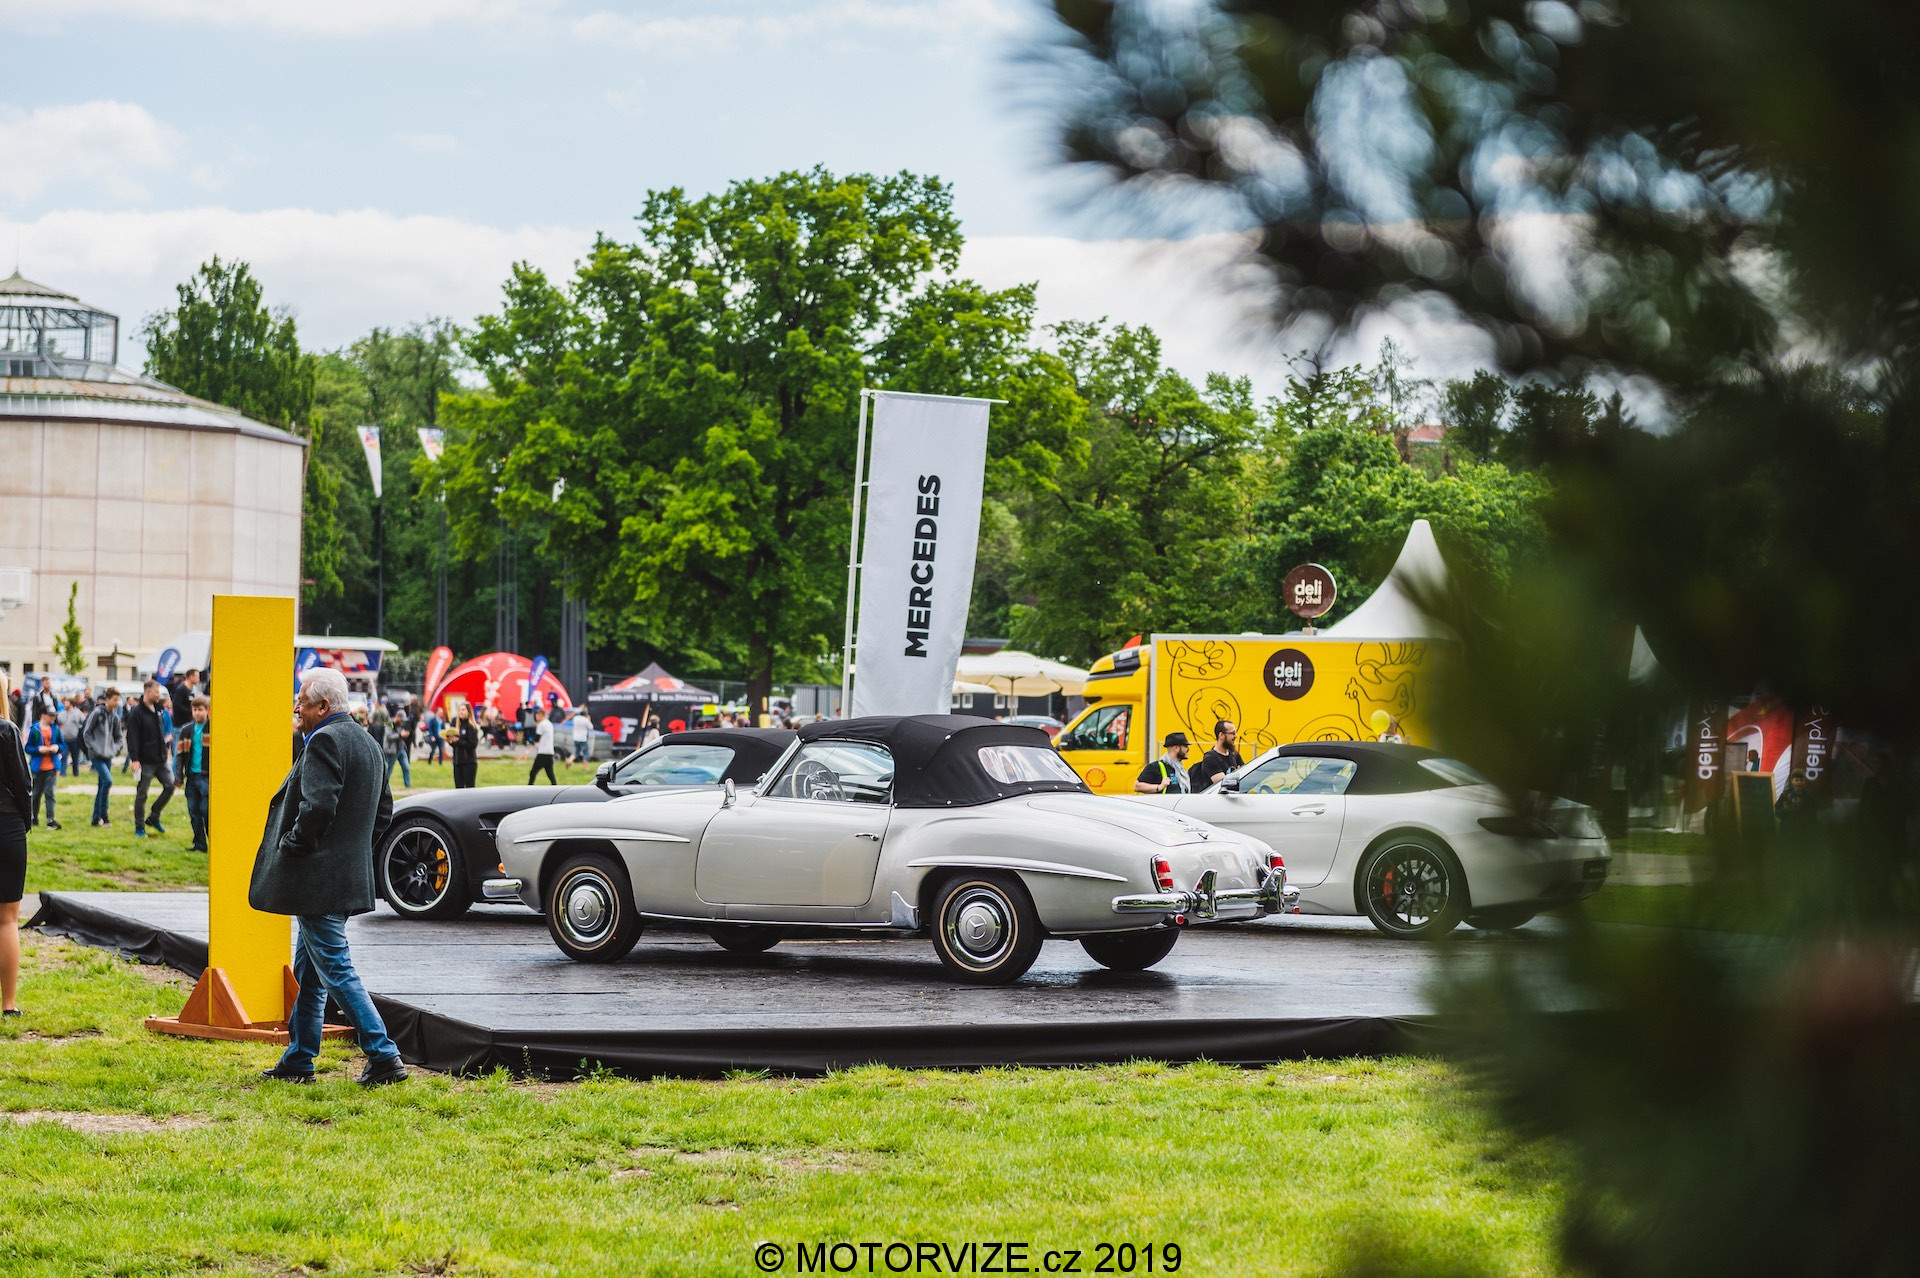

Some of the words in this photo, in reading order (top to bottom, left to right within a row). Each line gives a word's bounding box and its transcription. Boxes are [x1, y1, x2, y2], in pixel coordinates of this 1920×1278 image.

[904, 474, 942, 658] MERCEDES
[1294, 578, 1323, 596] deli
[1295, 596, 1305, 606] by
[1305, 596, 1322, 605] Shell
[1273, 661, 1303, 678] deli
[1274, 678, 1284, 689] by
[1285, 677, 1302, 687] Shell
